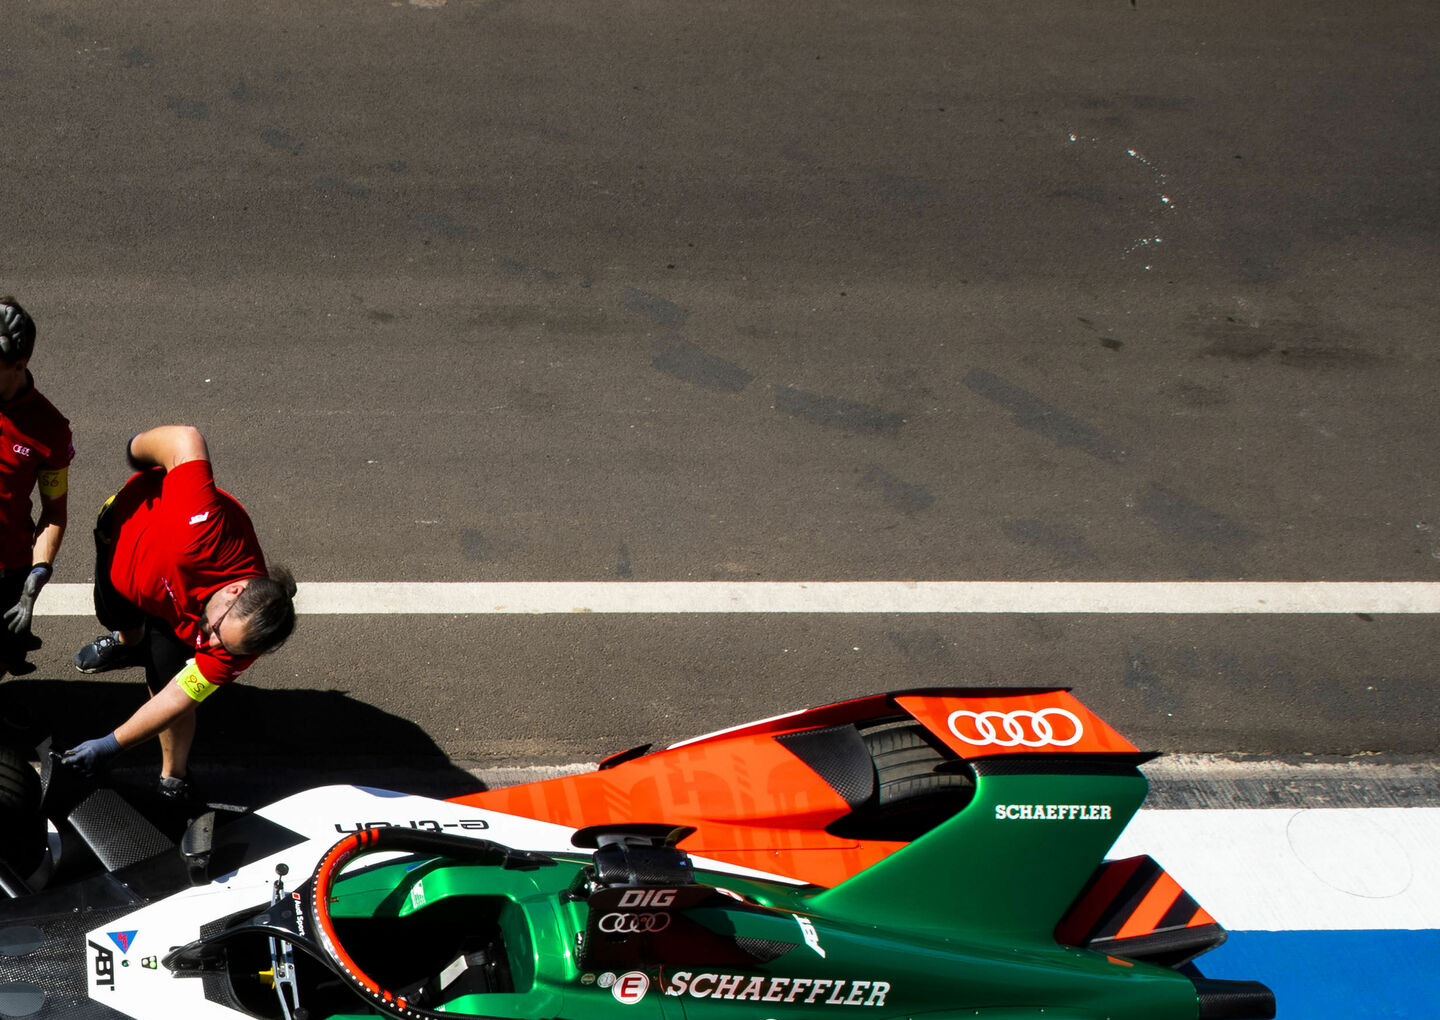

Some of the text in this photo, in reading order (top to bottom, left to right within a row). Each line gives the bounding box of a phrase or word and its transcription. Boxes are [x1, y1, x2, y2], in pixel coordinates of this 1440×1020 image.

[994, 804, 1112, 821] SCHAEFFLER
[617, 889, 678, 908] DIG
[294, 900, 306, 937] Audi Sport
[664, 970, 892, 1008] SCHAEFFLER
